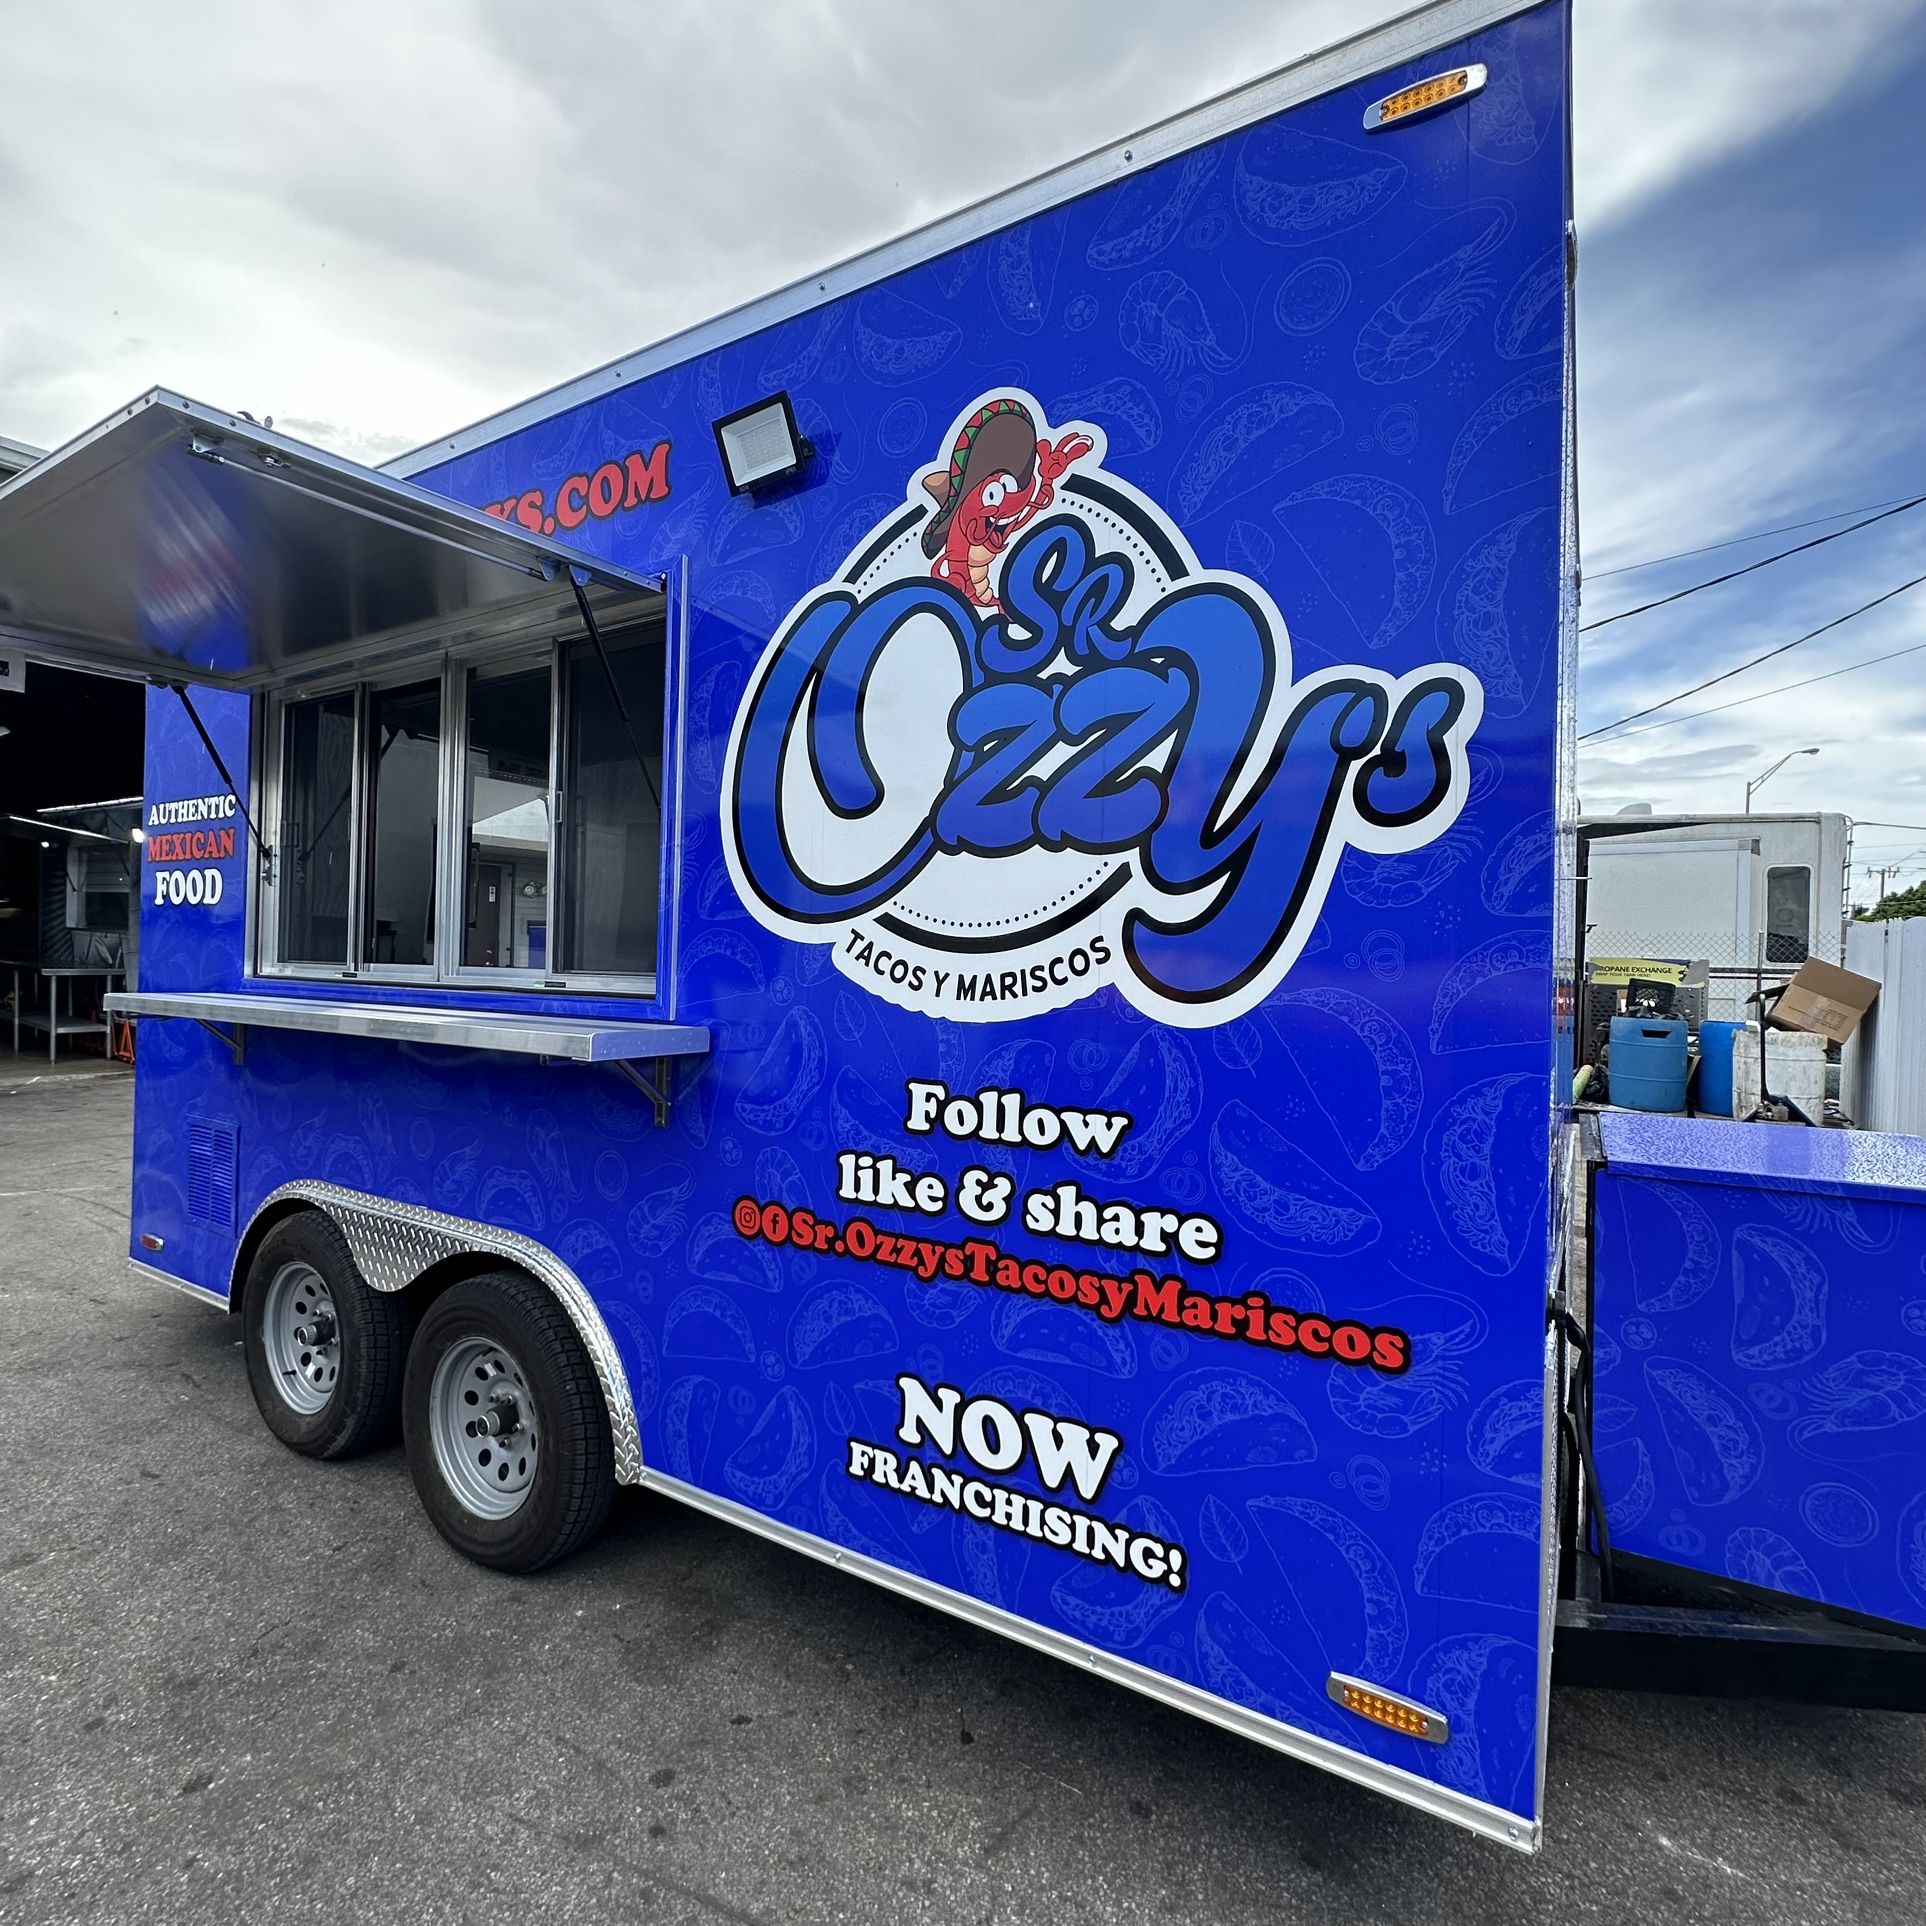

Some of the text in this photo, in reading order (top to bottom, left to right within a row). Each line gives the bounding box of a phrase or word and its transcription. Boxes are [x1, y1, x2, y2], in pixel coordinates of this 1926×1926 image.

[147, 828, 235, 862] MEXICAN
[148, 794, 236, 826] AUTHENTIC
[154, 868, 223, 905] FOOD
[845, 928, 1112, 1002] TACOS Y MARISCOS
[1631, 966, 1672, 974] EXCHANGE
[906, 1082, 1129, 1154] Follow
[839, 1154, 1219, 1260] like & share
[792, 1211, 1404, 1368] Sr.OzzysTacosyMariscos
[898, 1376, 1119, 1500] NOW
[849, 1441, 1183, 1588] FRANCHISING!
